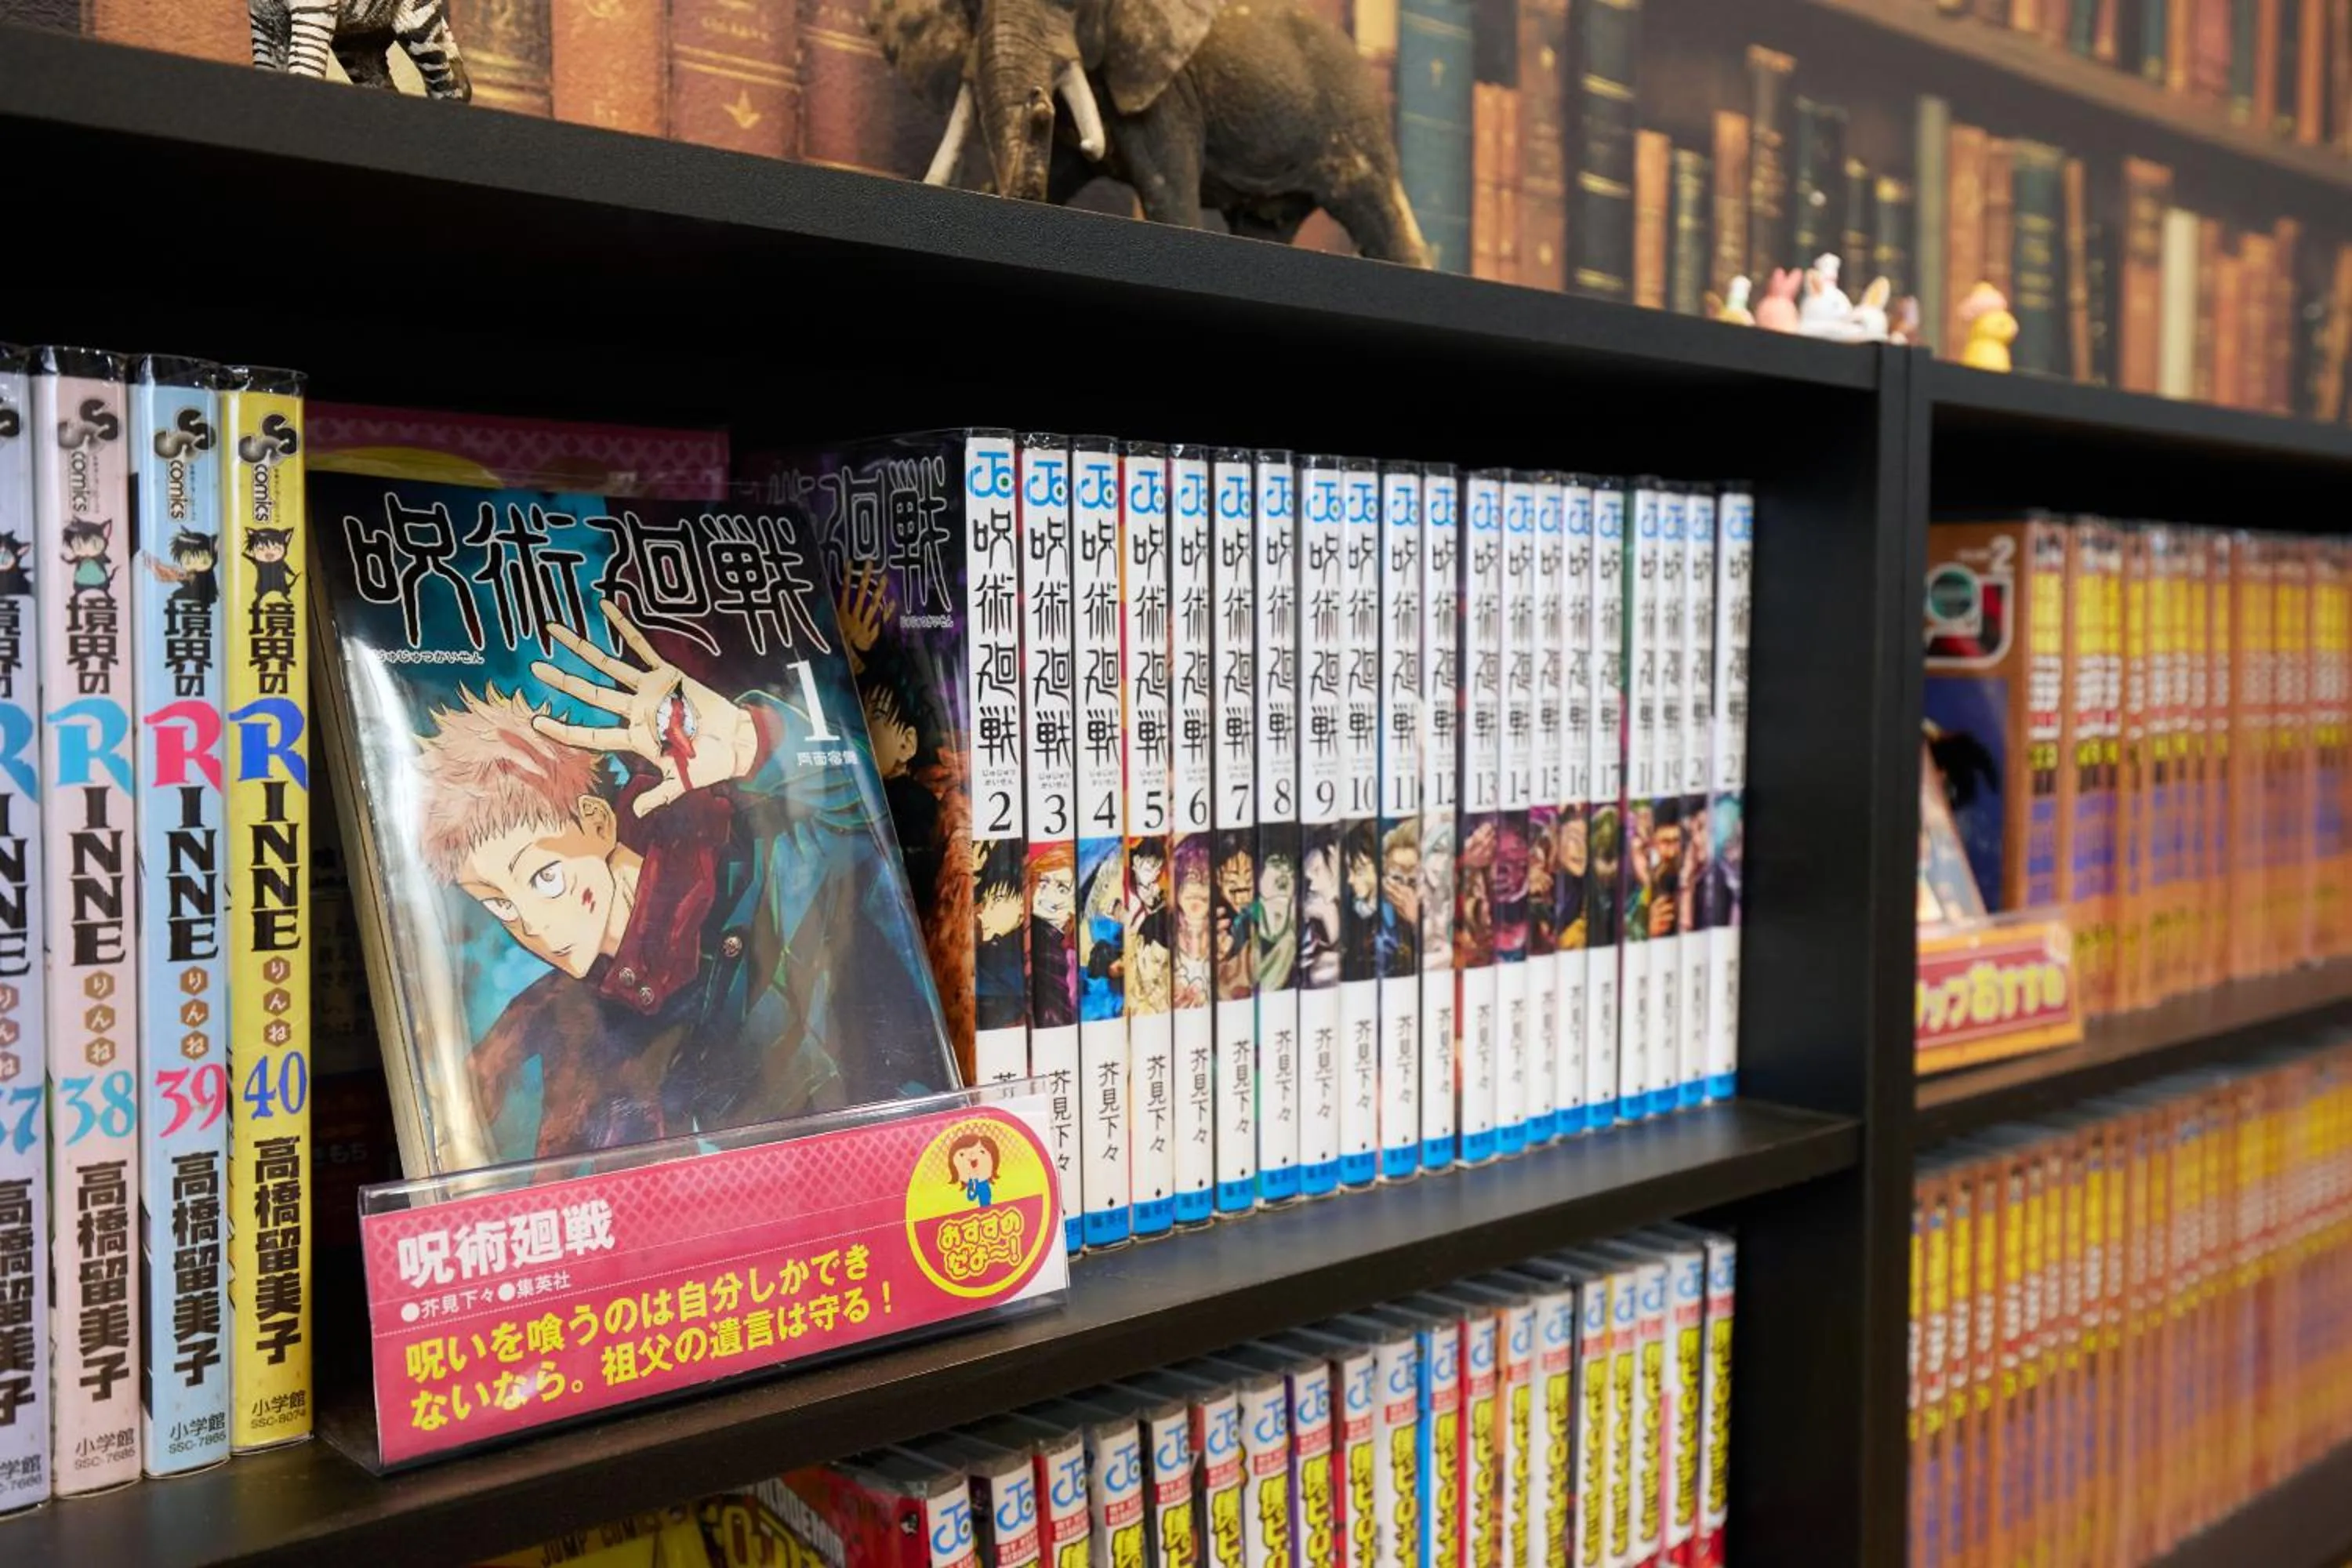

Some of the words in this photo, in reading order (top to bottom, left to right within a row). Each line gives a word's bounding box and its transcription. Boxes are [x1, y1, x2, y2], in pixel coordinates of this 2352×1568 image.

[343, 492, 832, 658] 呪術廻戦
[66, 597, 118, 694] 境界の
[164, 600, 213, 697] 境界の
[249, 602, 296, 695] 境界の
[973, 508, 1018, 768] 呪術廻戦
[1029, 516, 1072, 771] 呪術廻戦
[1081, 517, 1120, 768] 呪術廻戦
[1133, 523, 1167, 769] 呪術廻戦
[1181, 526, 1208, 768] 呪術廻戦
[1222, 526, 1253, 762] 呪術廻戦
[1266, 526, 1294, 757] 呪術廻戦
[1309, 532, 1340, 759] 呪術廻戦
[1347, 532, 1376, 756] 呪術廻戦
[1391, 536, 1418, 754] 呪術廻戦
[786, 659, 840, 741] 1
[47, 698, 134, 967] RINNE
[143, 700, 223, 962] RINNE
[228, 698, 308, 953] RINNE
[988, 791, 1012, 832] 2
[1044, 794, 1067, 835] 3
[1094, 790, 1116, 829] 4
[1144, 791, 1163, 829] 5
[1189, 788, 1207, 826] 6
[1231, 784, 1249, 821] 7
[1274, 779, 1292, 815] 8
[1316, 779, 1336, 816] 9
[1350, 775, 1377, 811] 10
[1394, 774, 1417, 810] 11
[86, 973, 114, 1065] りんね
[180, 968, 208, 1058] りんね
[264, 957, 290, 1045] りんね
[59, 1070, 137, 1148] 38
[156, 1062, 227, 1138] 39
[244, 1051, 307, 1120] 40
[1147, 1054, 1167, 1153] 芥見下々
[1190, 1047, 1209, 1145] 芥見下々
[1232, 1040, 1250, 1134] 芥見下々
[1275, 1030, 1293, 1121] 芥見下々
[1315, 1028, 1333, 1118] 芥見下々
[1355, 1019, 1373, 1109] 芥見下々
[0, 1087, 44, 1154] 7
[1048, 1069, 1071, 1172] 芥見下々
[1098, 1061, 1120, 1163] 芥見下々
[76, 1160, 129, 1402] 高橋留美子
[172, 1151, 221, 1388] 高橋留美子
[253, 1135, 303, 1366] 高橋留美子
[397, 1200, 615, 1288] 呪術廻戦
[406, 1243, 871, 1385] 呪いを喰うのは自分しかでき
[74, 1428, 134, 1456] 小学館
[169, 1412, 225, 1441] 小学館
[252, 1390, 307, 1417] 小学館
